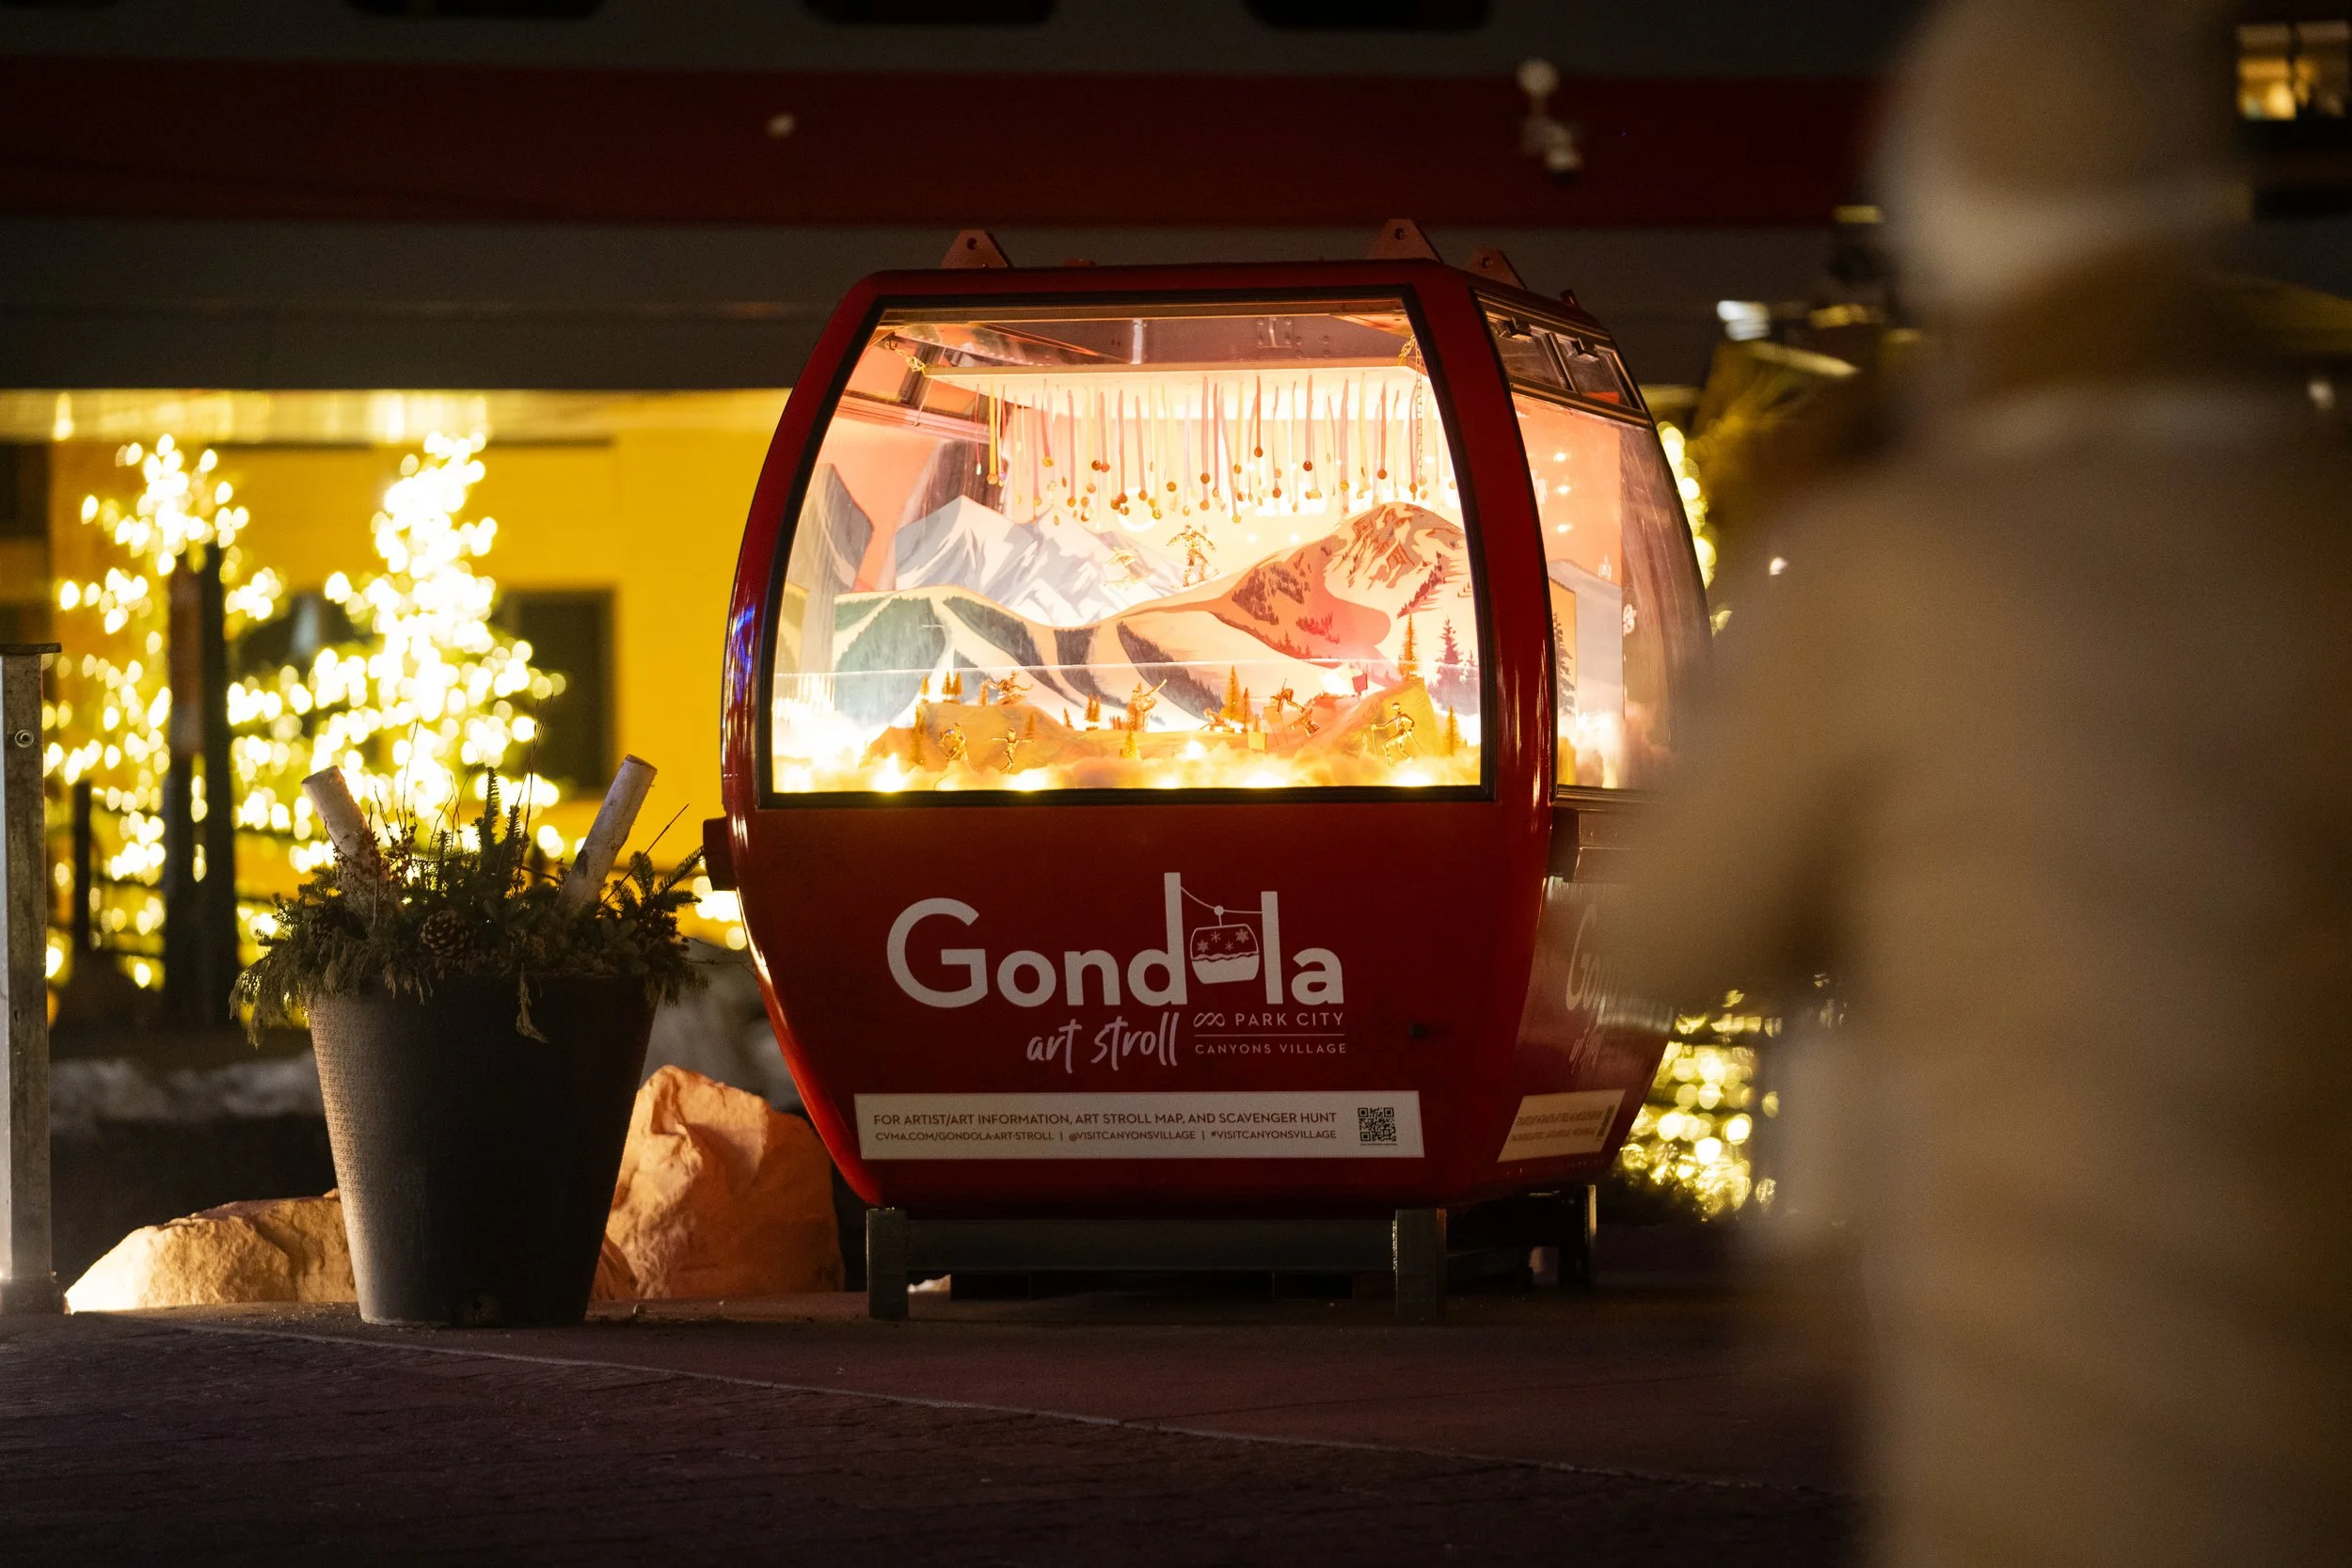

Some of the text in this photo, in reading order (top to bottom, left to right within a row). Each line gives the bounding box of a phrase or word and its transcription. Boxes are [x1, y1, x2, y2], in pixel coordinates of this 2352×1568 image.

[1234, 1011, 1344, 1026] PARK CITY
[1025, 1011, 1180, 1074] art stroll
[1194, 1042, 1347, 1054] CANYONS VILLAGE
[873, 1112, 1338, 1128] FOR ARTIST/ART INFORMATION, ART STROLL MAP, AND SCAVENGER HUNT
[1068, 1131, 1197, 1143] @VISITCANYONSVILLAGE
[1210, 1130, 1337, 1140] #VISITCANYONSVILLAGE
